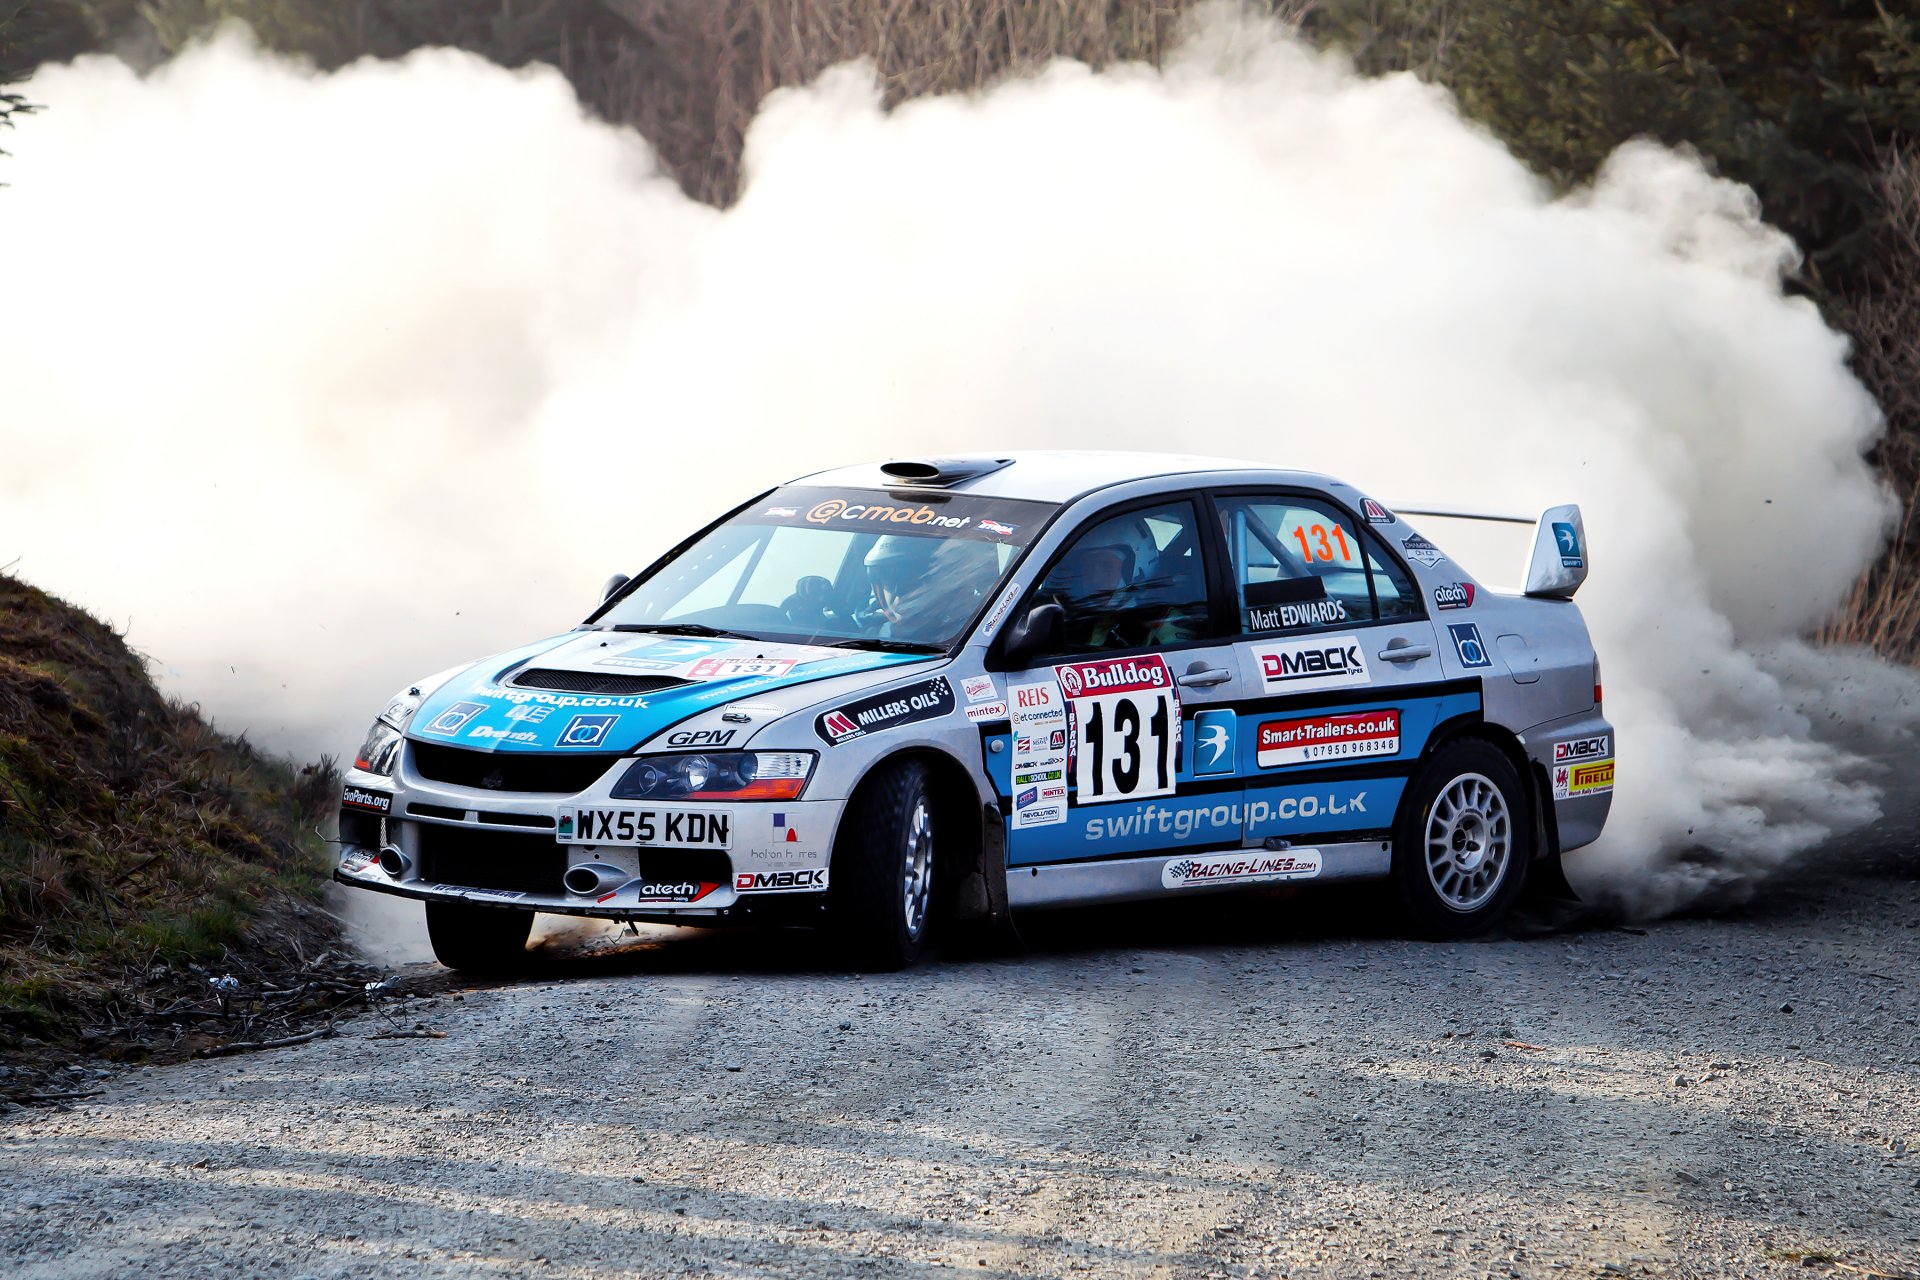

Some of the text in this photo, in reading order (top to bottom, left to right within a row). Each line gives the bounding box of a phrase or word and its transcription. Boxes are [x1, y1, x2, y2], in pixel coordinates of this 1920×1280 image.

[1293, 523, 1352, 563] 131
[1435, 582, 1468, 602] atech
[1250, 600, 1346, 631] Matt EDWARDS
[730, 664, 777, 673] 131
[1081, 661, 1165, 689] Bulldog
[857, 690, 941, 726] MILLERS OILS
[1017, 687, 1049, 708] REIS
[967, 705, 1001, 718] mintex
[1028, 708, 1063, 720] connected
[667, 729, 737, 745] GPM
[1068, 712, 1077, 757] BTRDA
[1262, 716, 1396, 744] Smart-Trailers.co.uk
[1085, 694, 1169, 796] 131
[1313, 739, 1394, 757] 07950 968348
[343, 788, 390, 811] EvoParts.org
[1043, 788, 1065, 797] MINTEX
[1022, 808, 1058, 819] REVOLUTION
[1085, 791, 1367, 842] swiftgroup.co.uk
[577, 809, 730, 844] WX55 KDN
[641, 881, 695, 895] atech
